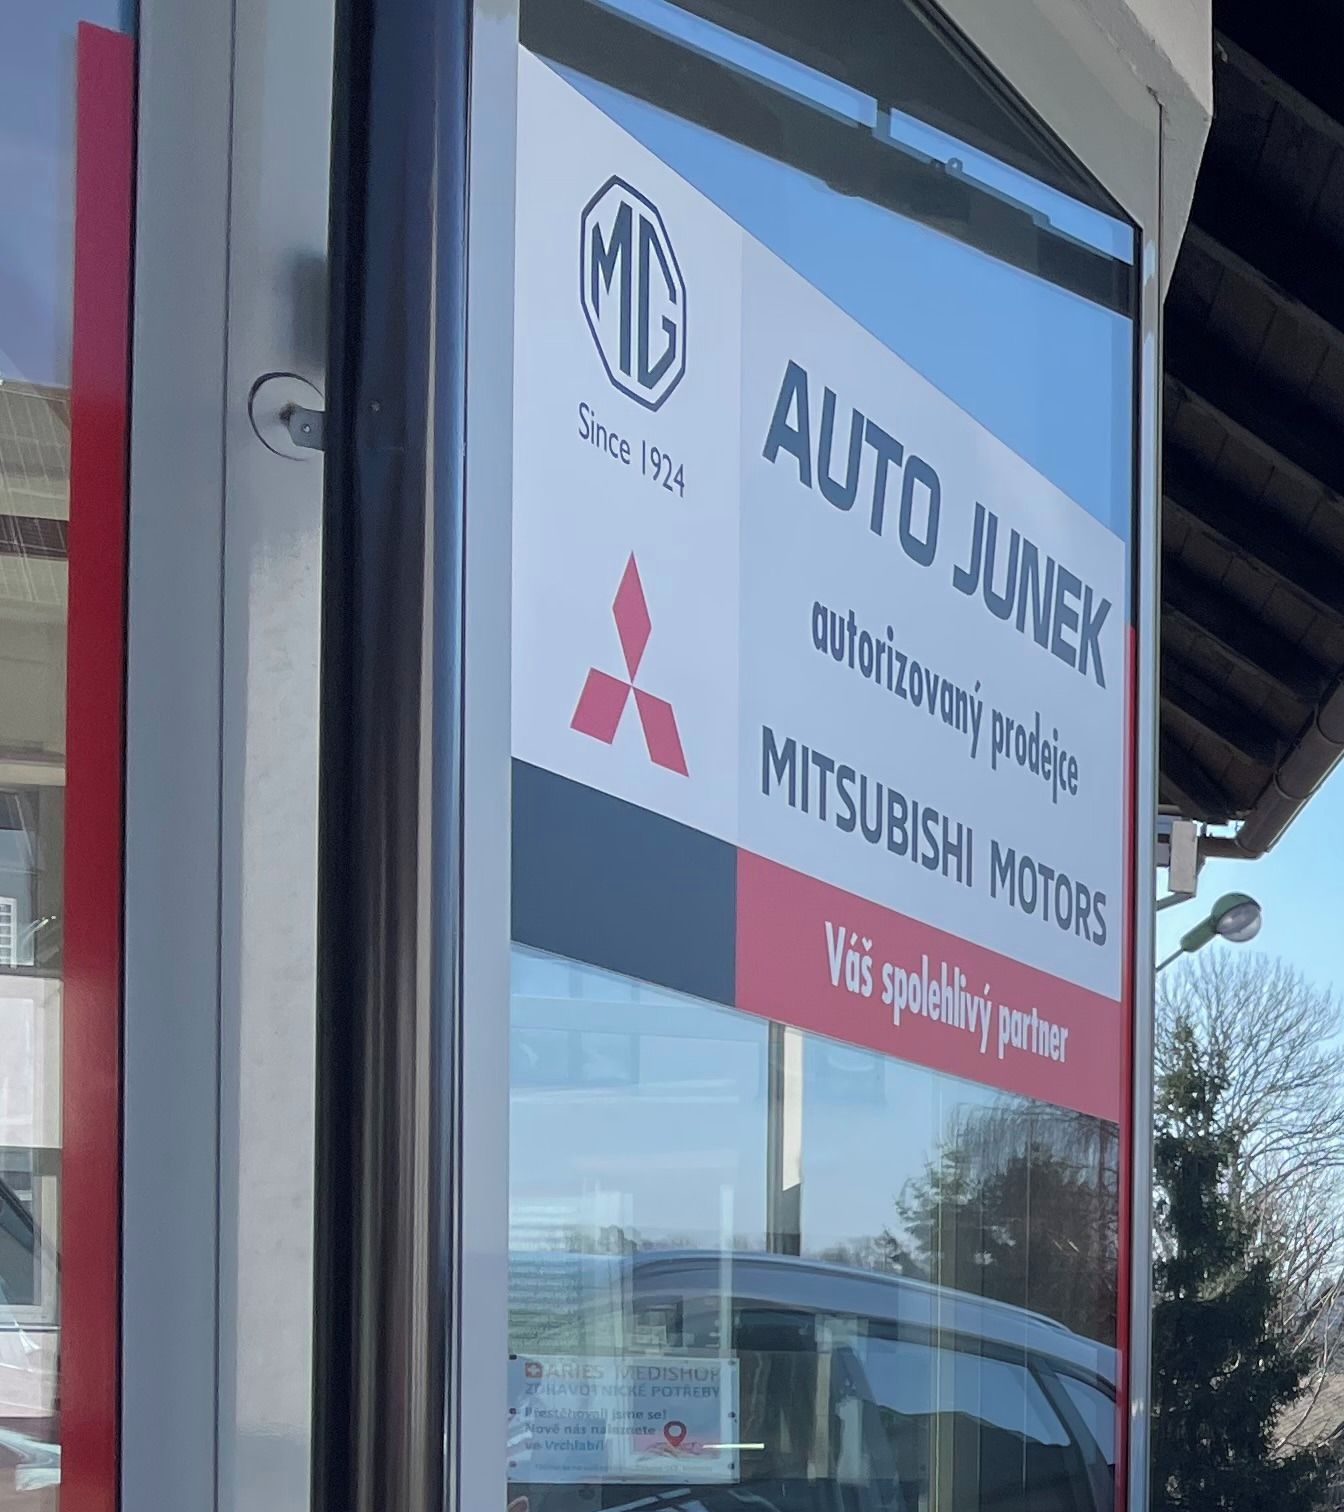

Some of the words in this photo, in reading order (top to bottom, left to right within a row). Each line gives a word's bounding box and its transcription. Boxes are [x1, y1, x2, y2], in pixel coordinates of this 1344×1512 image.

[591, 199, 677, 390] MG
[578, 402, 631, 465] Since
[641, 439, 685, 497] 1924
[762, 359, 941, 567] AUTO
[952, 502, 1112, 690] JUNEK
[812, 600, 981, 760] autorizovaný
[991, 708, 1079, 804] prodejce
[761, 725, 973, 887] MITSUBISHI
[990, 839, 1107, 946] MOTORS
[824, 920, 874, 998] Váš
[881, 954, 992, 1054] spolehlivý
[998, 1004, 1069, 1059] partner
